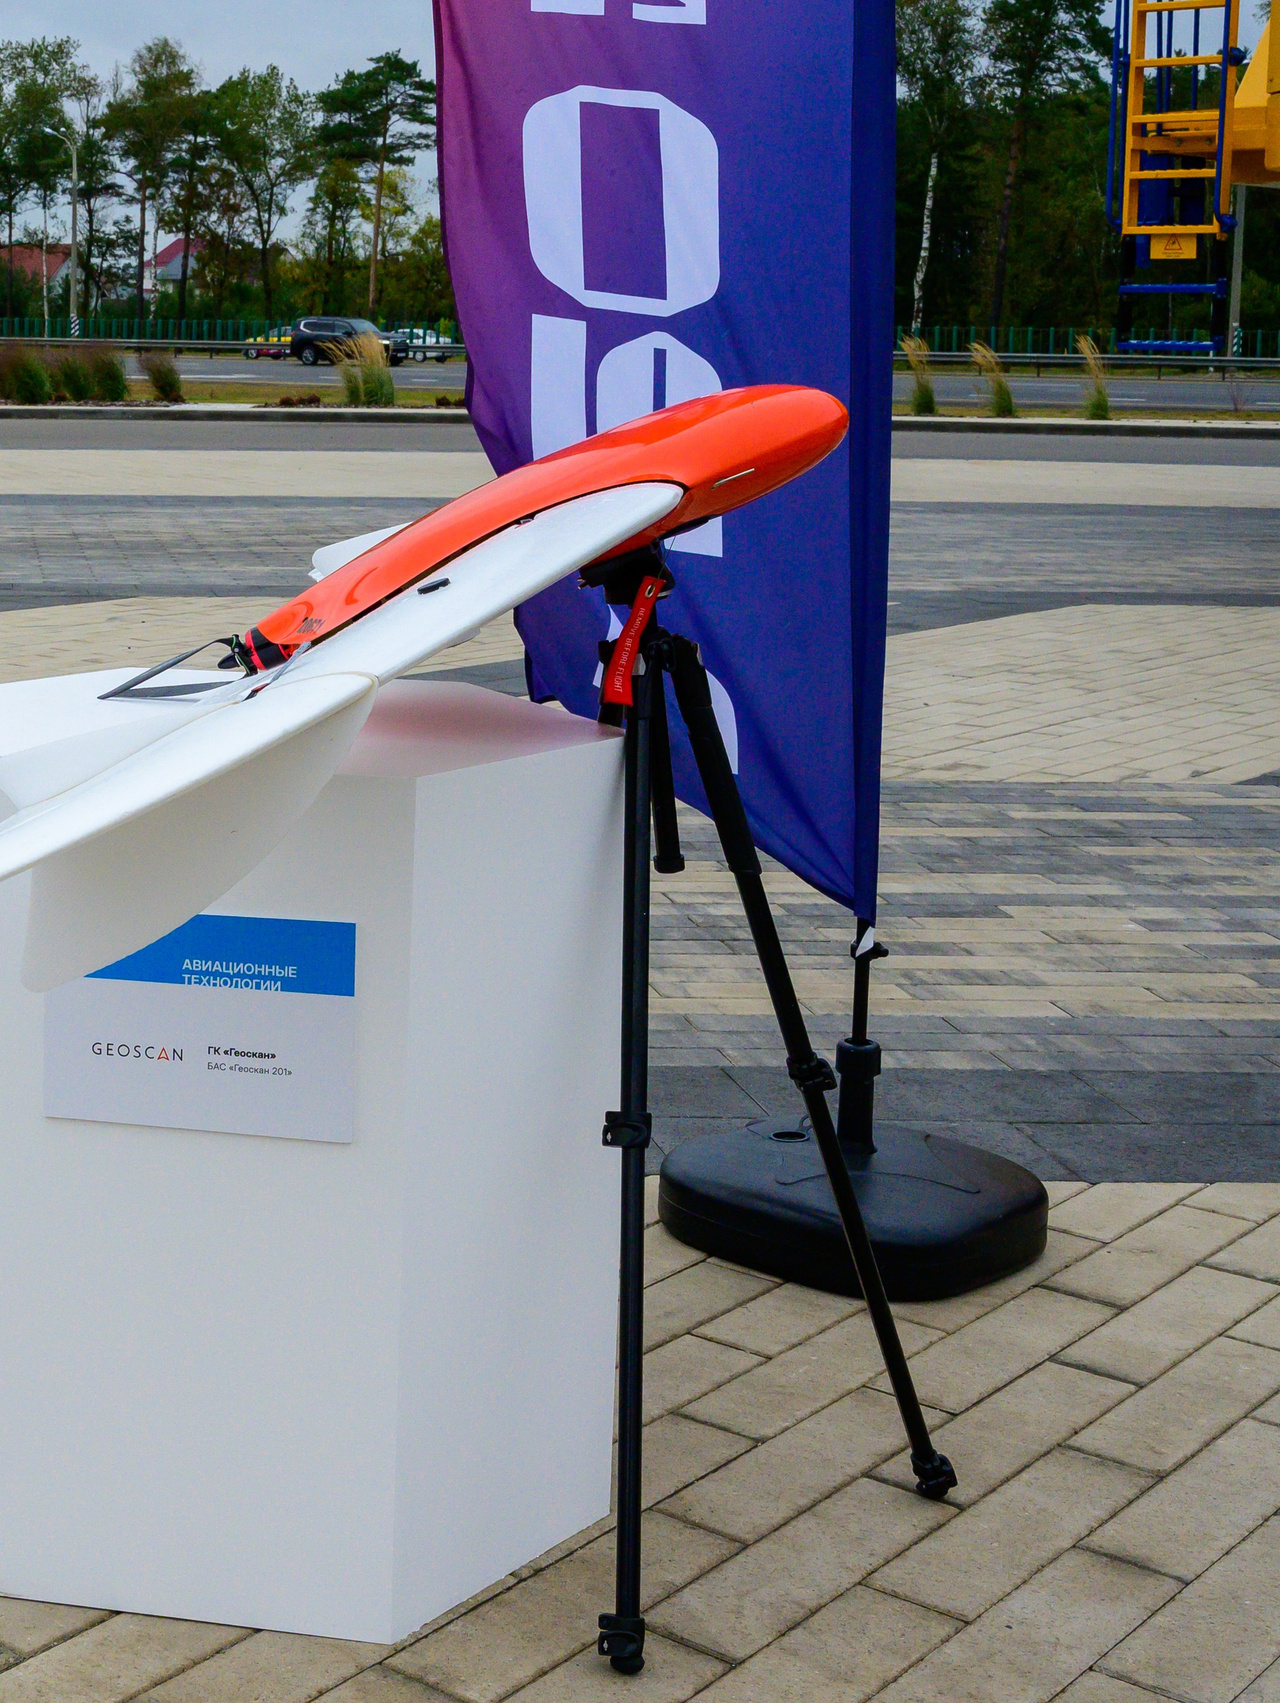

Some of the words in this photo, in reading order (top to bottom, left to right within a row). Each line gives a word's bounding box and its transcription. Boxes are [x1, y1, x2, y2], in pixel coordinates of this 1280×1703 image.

[629, 607, 645, 636] REMOVE
[619, 638, 633, 668] BEFORE
[614, 667, 624, 692] FLIGHT
[182, 959, 297, 978] АВИАЦИОННЫЕ
[182, 974, 281, 992] ТЕХНОЛОГИИ
[91, 1042, 184, 1062] GEOSCAN
[207, 1046, 221, 1056] ГК
[223, 1047, 277, 1060] «Геоскан»
[207, 1062, 227, 1072] БАС
[229, 1064, 270, 1075] «Геоскан
[272, 1067, 293, 1076] 201»
